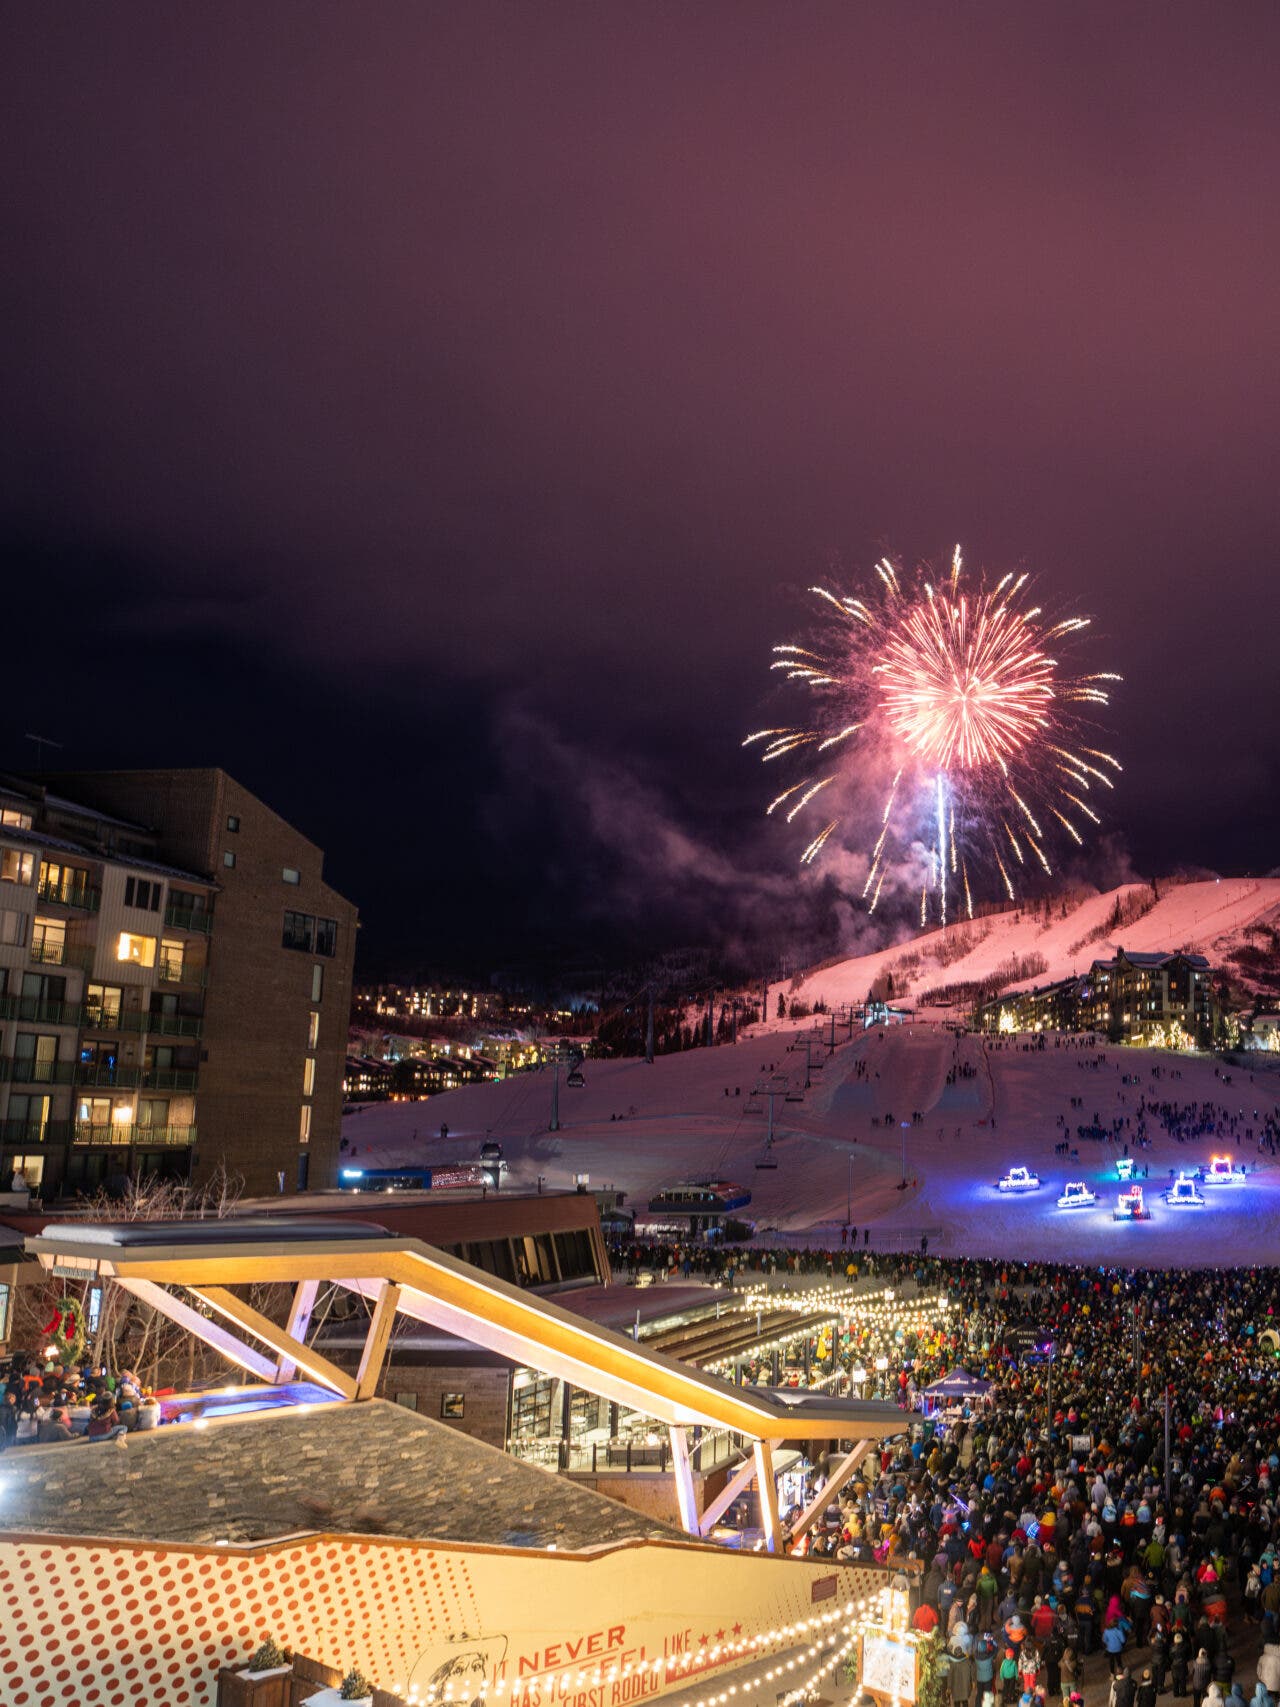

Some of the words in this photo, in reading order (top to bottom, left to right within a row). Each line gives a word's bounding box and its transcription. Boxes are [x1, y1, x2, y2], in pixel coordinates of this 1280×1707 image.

[518, 1625, 626, 1676] NEVER
[664, 1628, 692, 1659] LIKE
[611, 1666, 660, 1706] RODEO
